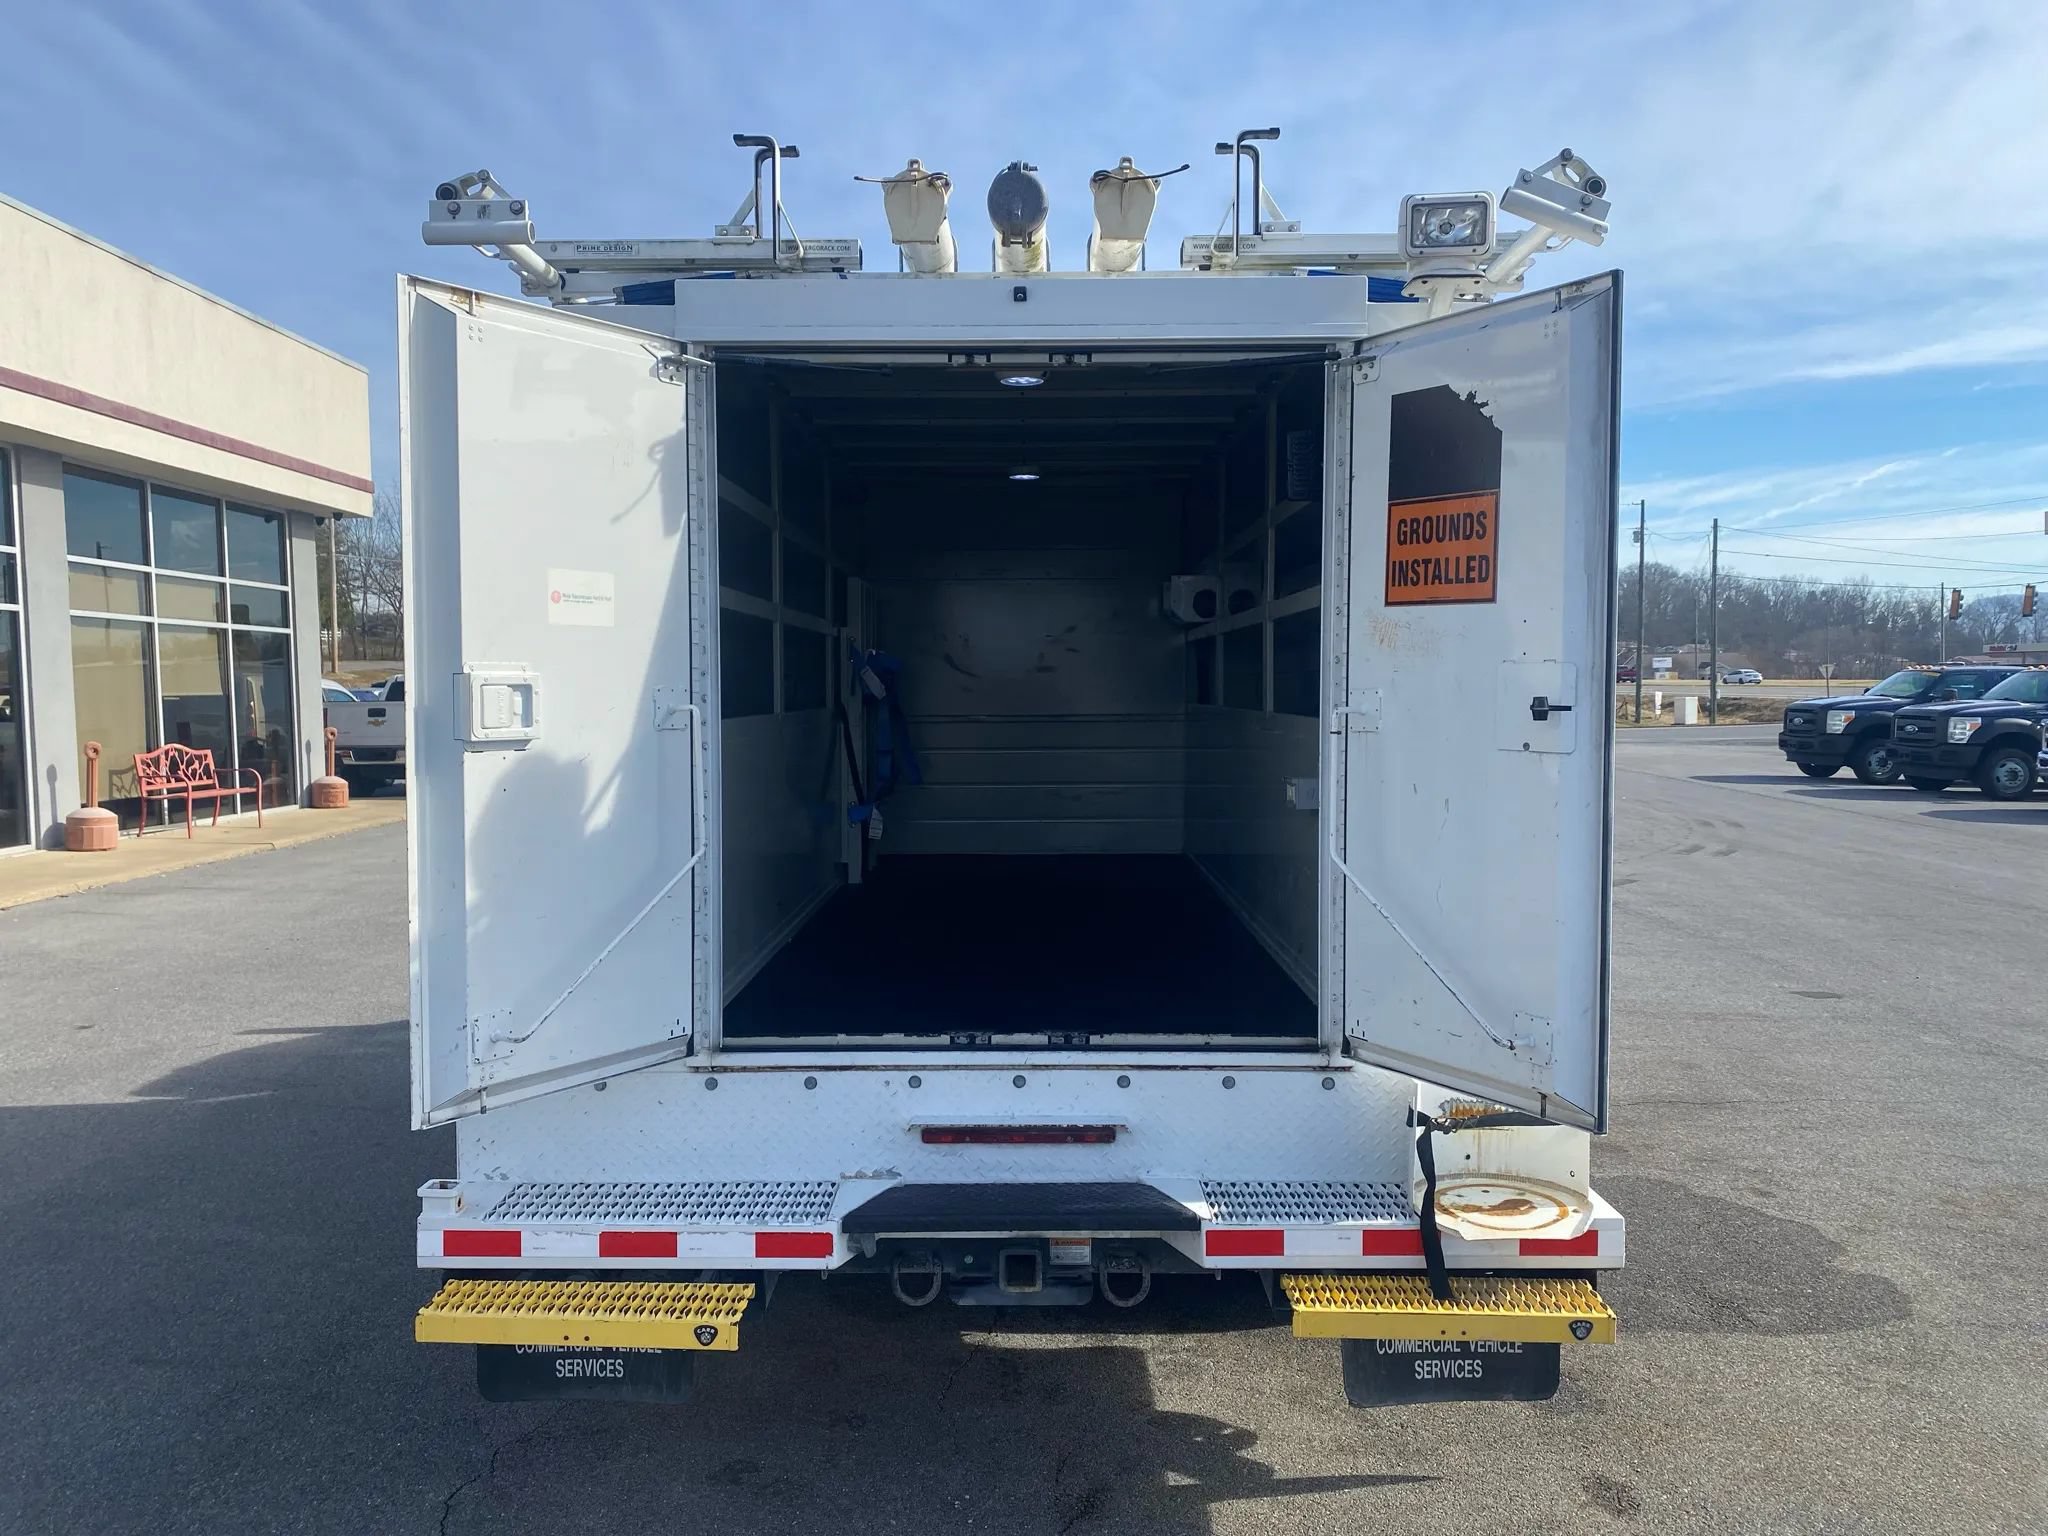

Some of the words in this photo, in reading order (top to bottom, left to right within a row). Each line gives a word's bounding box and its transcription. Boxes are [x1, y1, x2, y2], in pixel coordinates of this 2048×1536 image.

[1397, 510, 1488, 546] GROUNDS
[1391, 554, 1490, 588] INSTALLED
[1376, 1338, 1461, 1354] COMMERCIAL
[555, 1358, 624, 1378] SERVICES
[1414, 1359, 1483, 1380] SERVICES
